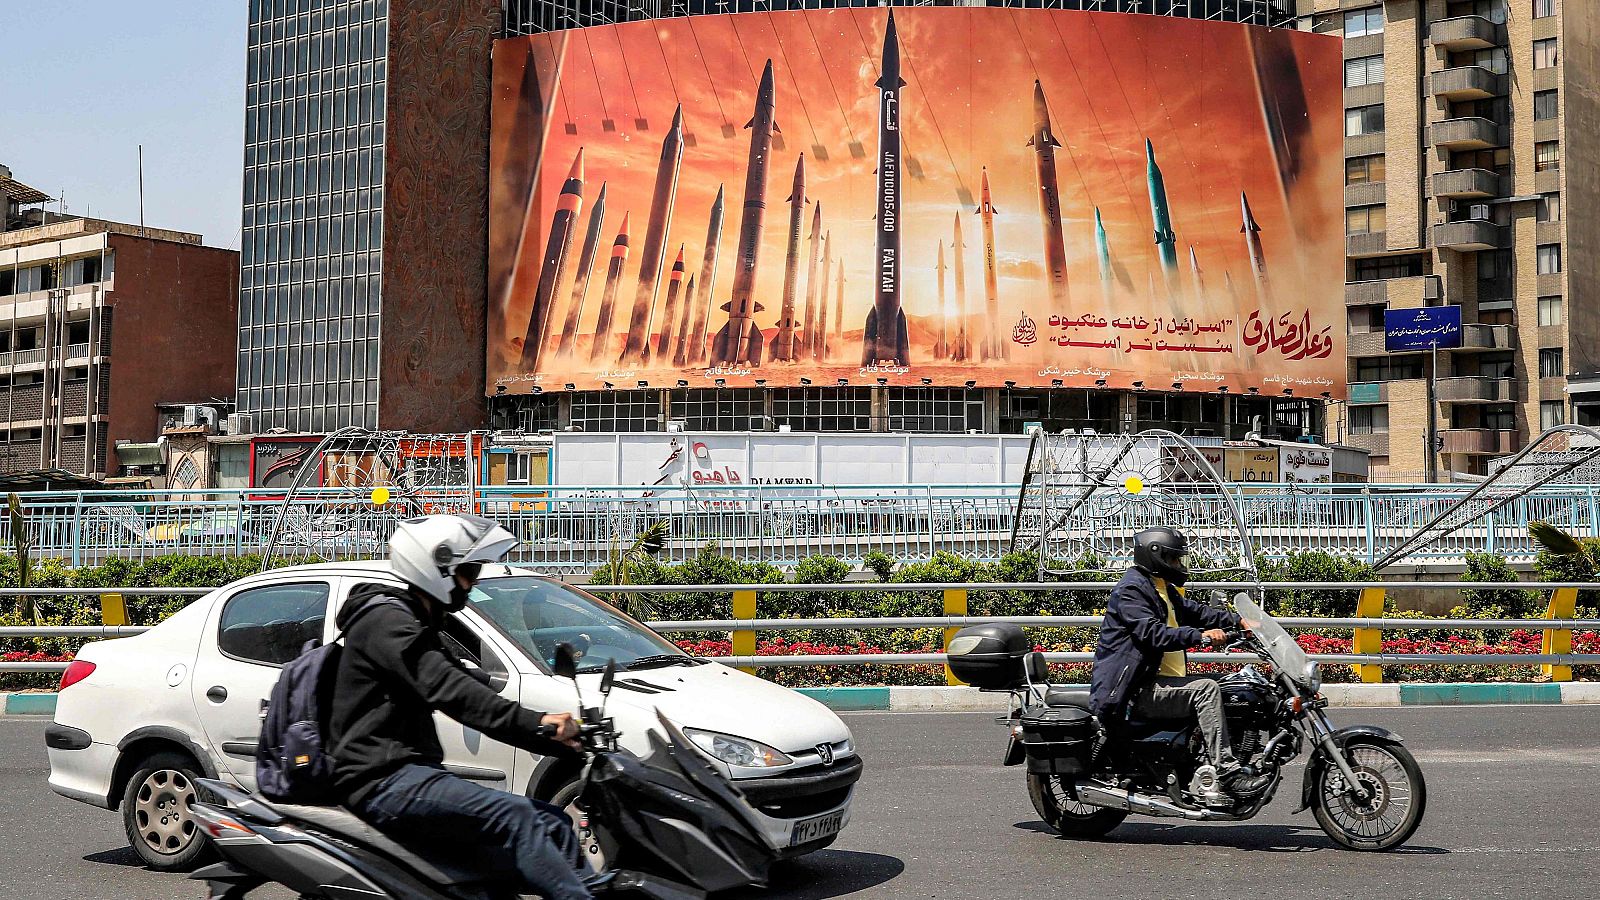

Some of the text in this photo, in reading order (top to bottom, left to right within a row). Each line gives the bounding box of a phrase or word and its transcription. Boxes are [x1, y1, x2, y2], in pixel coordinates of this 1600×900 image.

[882, 248, 895, 293] FATTAH
[1048, 313, 1108, 331] عنکبوت
[1111, 315, 1150, 330] خانه
[1151, 316, 1163, 335] از
[1125, 337, 1153, 353] تر
[610, 369, 635, 379] موشک
[704, 366, 751, 378] موشک فاتح
[859, 364, 909, 377] موشک فتاح
[1038, 366, 1111, 380] موشک خیبر شکن
[1173, 370, 1225, 382] موشک سجیل
[521, 373, 543, 384] موشک
[1263, 374, 1334, 387] موشک شهید حاج قاسم
[1253, 453, 1275, 463] فروشگاه
